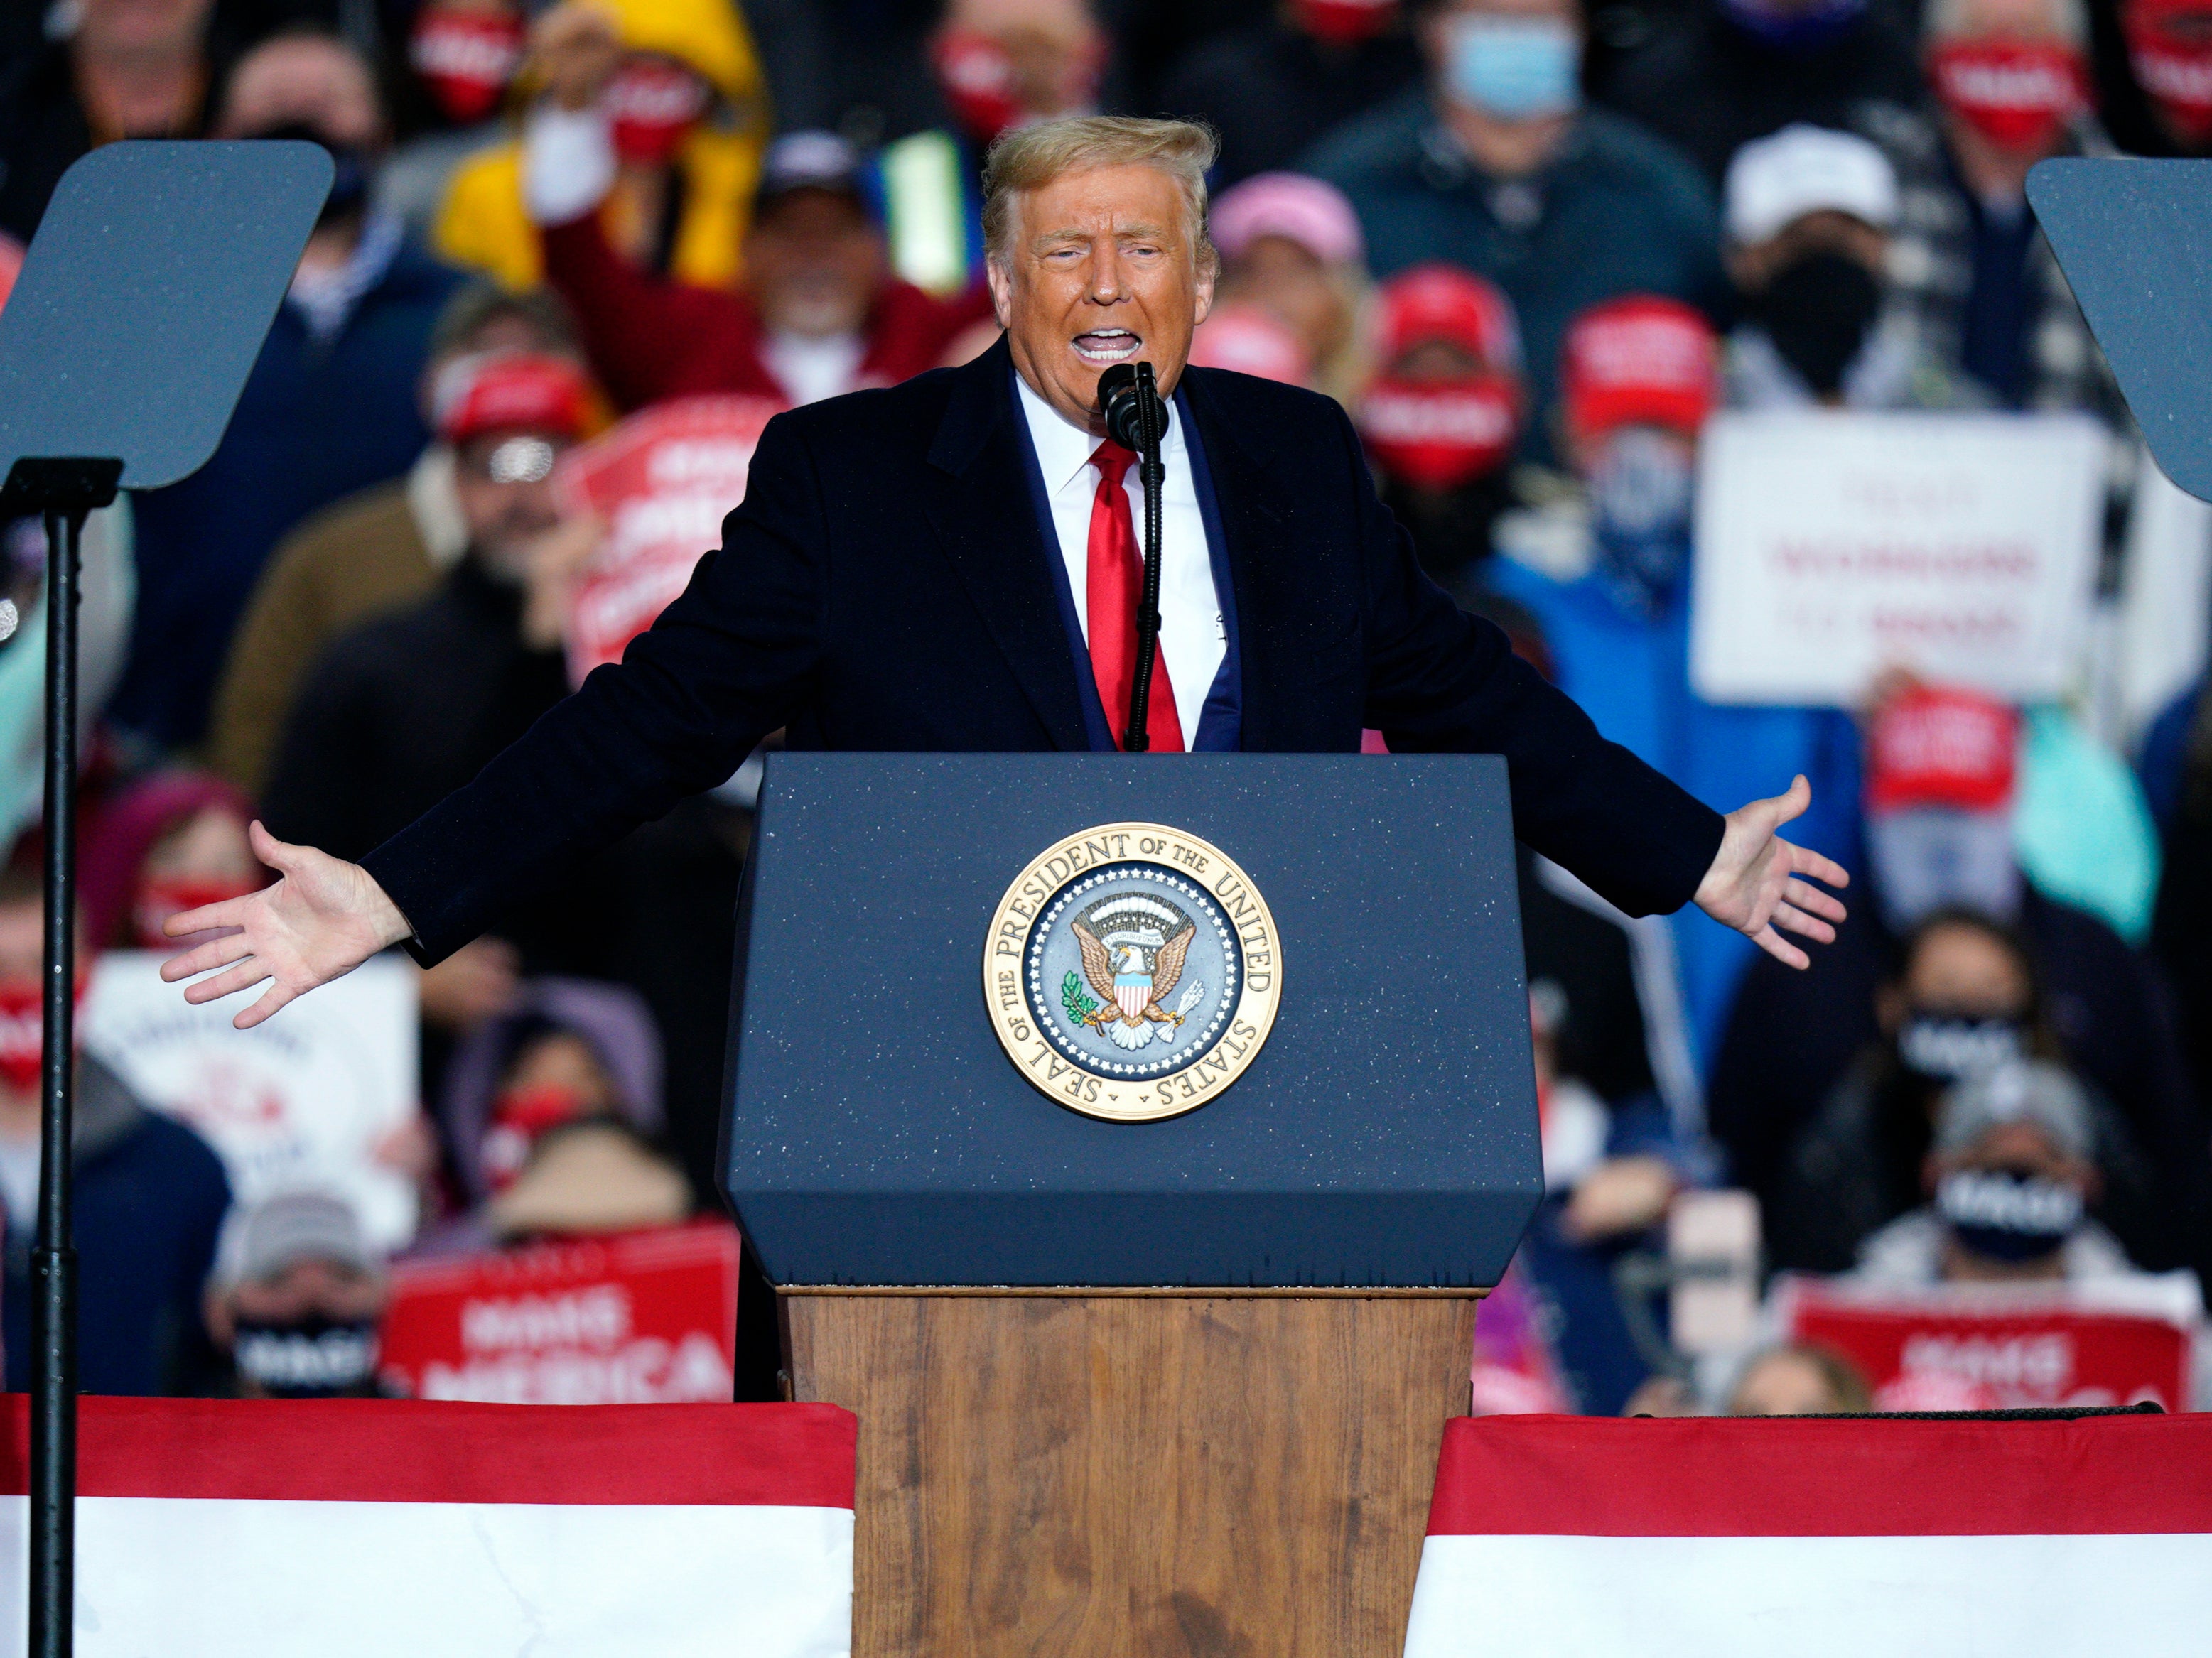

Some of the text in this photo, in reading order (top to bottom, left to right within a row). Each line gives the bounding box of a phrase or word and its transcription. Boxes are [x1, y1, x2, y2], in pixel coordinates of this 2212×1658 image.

[996, 833, 1272, 1105] SEAL OF THE PRESIDENT OF THE UNITED STATES
